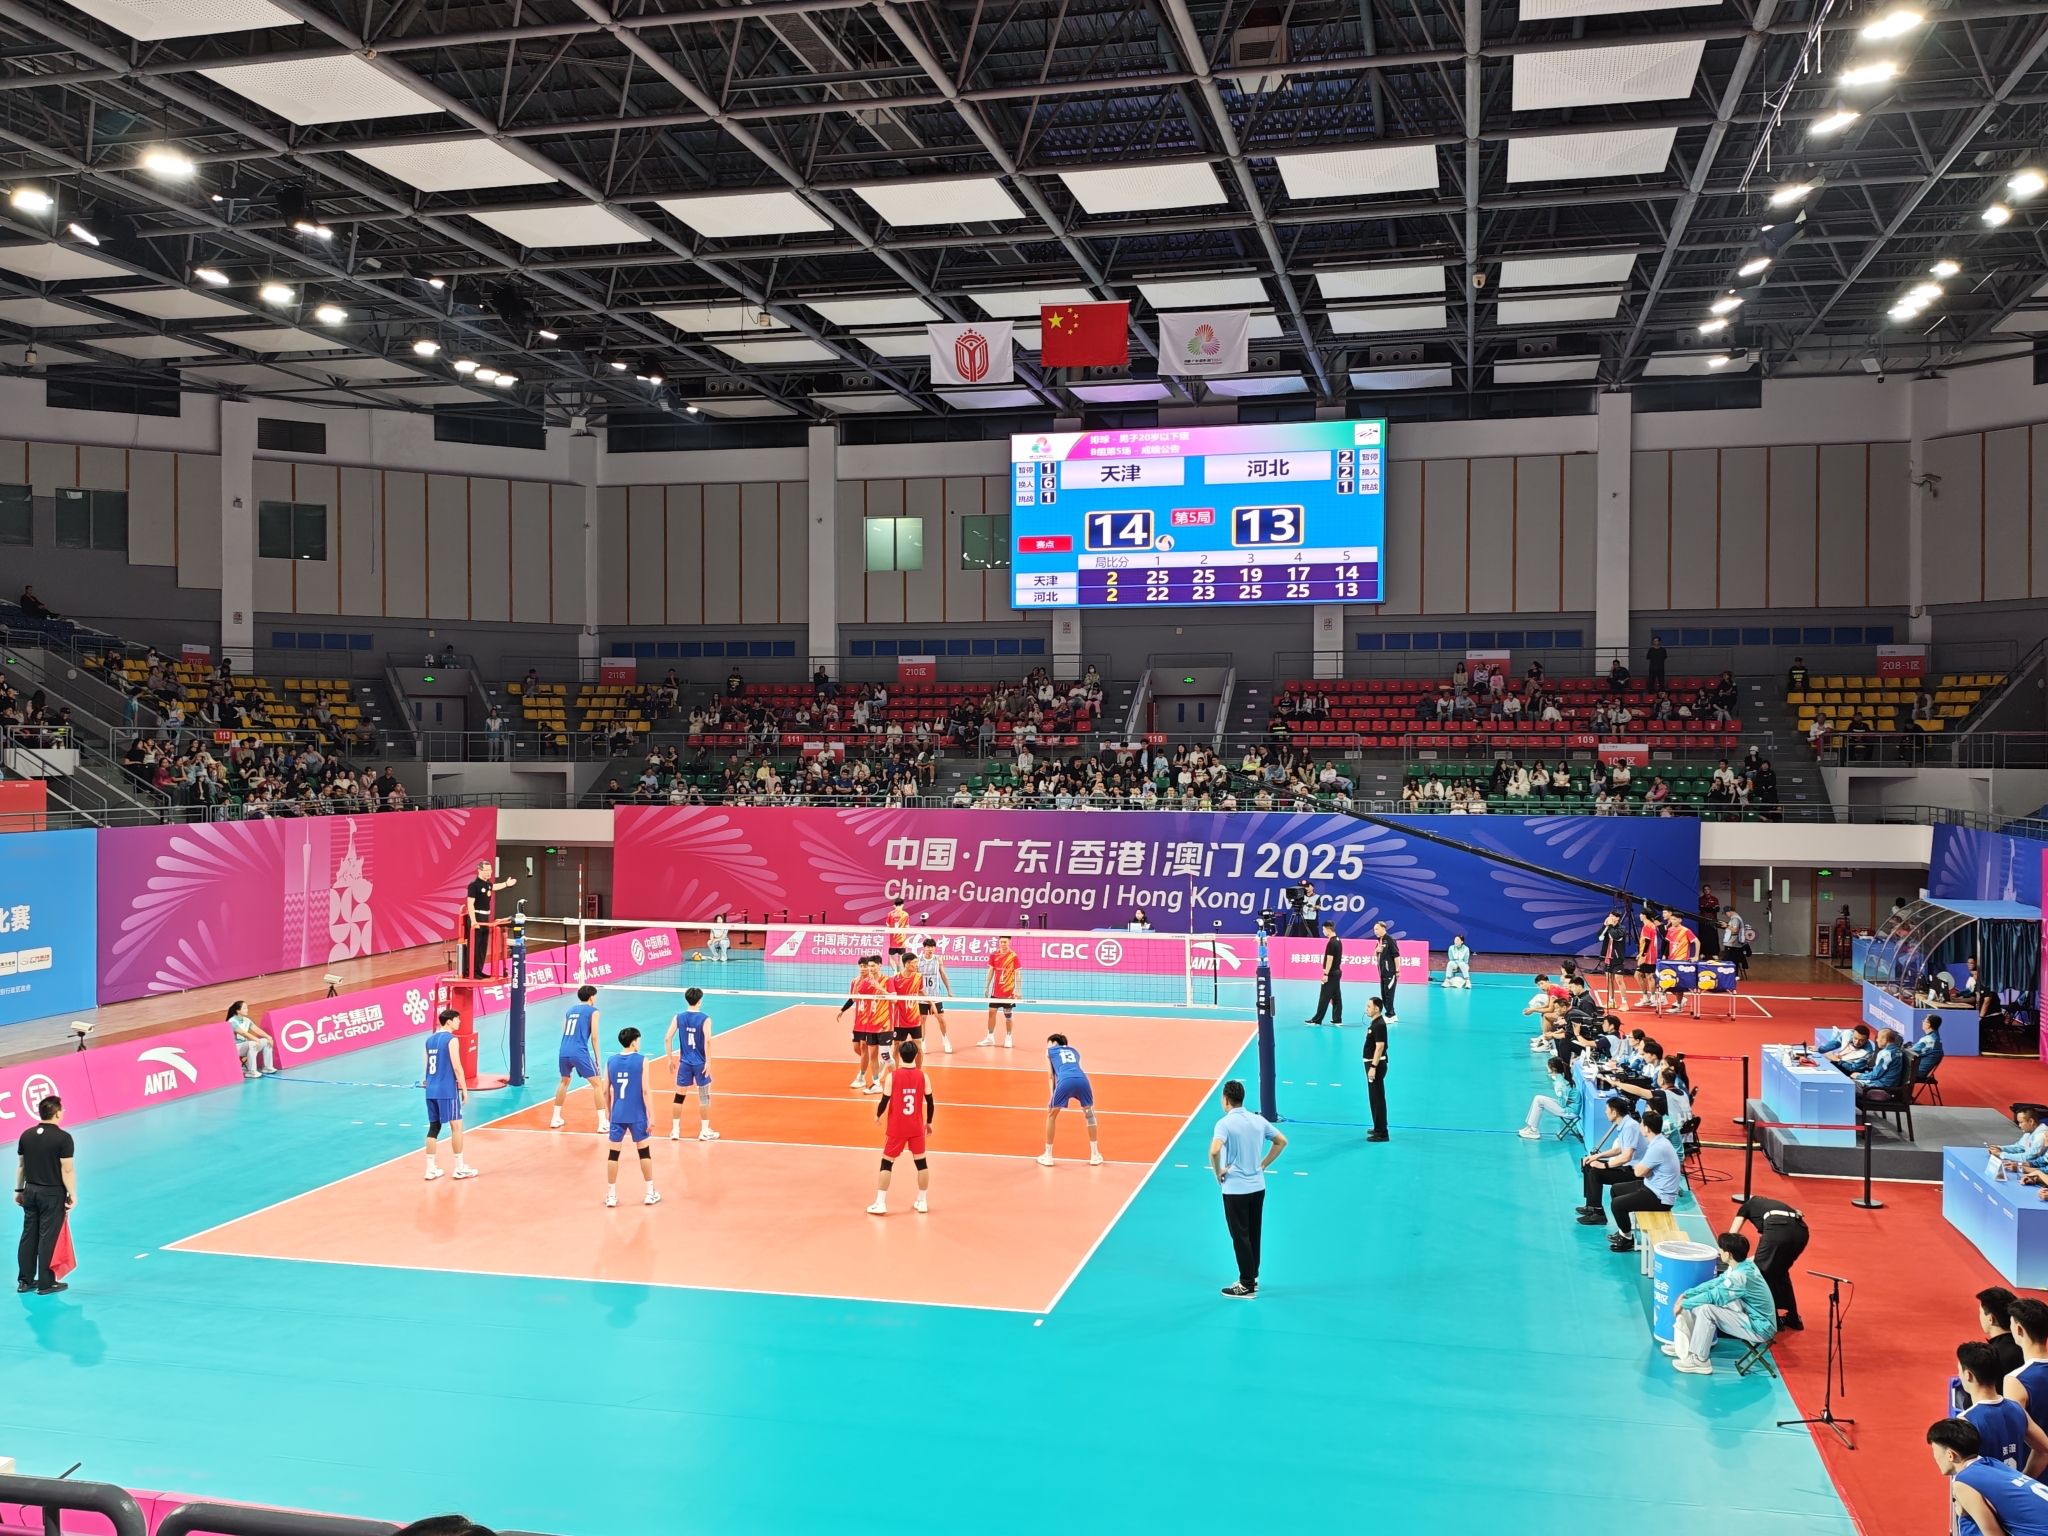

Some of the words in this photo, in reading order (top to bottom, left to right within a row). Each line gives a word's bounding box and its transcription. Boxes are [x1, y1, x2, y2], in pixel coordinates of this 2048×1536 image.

[1340, 451, 1351, 463] 2
[1044, 463, 1052, 474] 1
[1100, 464, 1141, 482] 天津
[1247, 459, 1290, 477] 河北
[1340, 466, 1351, 478] 2
[1361, 468, 1378, 476] 换人
[1043, 477, 1054, 488] 6
[1341, 481, 1350, 492] 1
[1361, 483, 1378, 491] 挑战
[1044, 492, 1052, 503] 1
[1174, 510, 1211, 525] 第5局
[1094, 514, 1148, 546] 14
[1242, 509, 1295, 542] 13
[1036, 540, 1055, 549] 赛点
[1095, 556, 1129, 568] 局比分
[1155, 556, 1160, 566] 1
[1200, 555, 1208, 565] 2
[1248, 553, 1255, 563] 3
[1294, 552, 1302, 562] 4
[1343, 551, 1350, 561] 5
[1034, 575, 1058, 586] 天津
[1107, 572, 1118, 585] 2
[1146, 570, 1169, 584] 25
[1192, 569, 1215, 583] 25
[1239, 568, 1262, 582] 19
[1287, 566, 1311, 581] 17
[1335, 565, 1359, 580] 14
[1034, 591, 1058, 602] 河北
[1107, 588, 1118, 601] 2
[1146, 587, 1169, 600] 22
[1192, 586, 1215, 600] 23
[1239, 585, 1262, 599] 25
[1286, 584, 1310, 597] 25
[1335, 583, 1358, 597] 13
[905, 668, 927, 676] 210区
[1882, 661, 1920, 670] 208-1区
[608, 671, 626, 679] 211区
[1148, 735, 1163, 743] 110
[1254, 842, 1366, 881] 2025
[1117, 884, 1183, 914] Hong
[1191, 887, 1255, 915] Kong
[644, 934, 670, 950] 中国移动
[813, 933, 884, 947] 中国南方航空
[811, 946, 837, 956] CHINA
[839, 947, 883, 957] SOUTHERN
[1040, 942, 1089, 960] ICBC
[925, 977, 933, 987] 16
[316, 1004, 384, 1035] 广汽集团
[318, 1029, 344, 1044] GAC
[344, 1020, 385, 1039] GROUP
[565, 1019, 577, 1036] 11
[429, 1054, 437, 1075] 8
[1059, 1051, 1077, 1064] 13
[144, 1069, 178, 1096] ANTA
[617, 1078, 629, 1099] 7
[902, 1094, 915, 1115] 3
